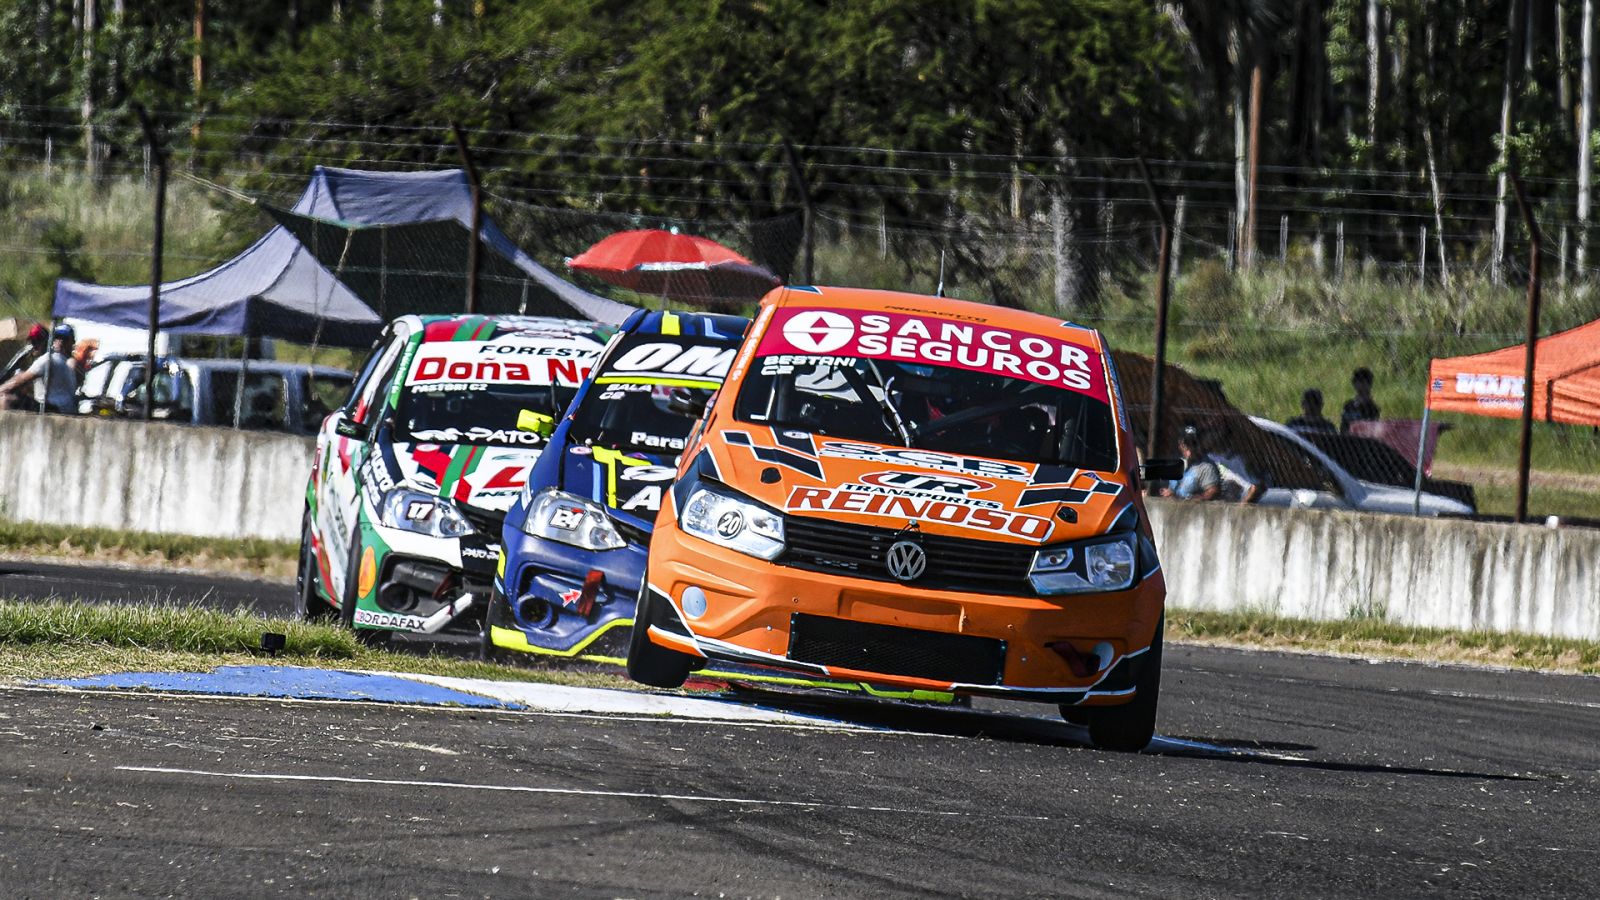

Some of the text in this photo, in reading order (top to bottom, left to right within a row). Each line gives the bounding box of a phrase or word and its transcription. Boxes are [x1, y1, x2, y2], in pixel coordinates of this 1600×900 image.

[860, 314, 1092, 373] SANCOR
[413, 357, 531, 381] Doña
[613, 342, 737, 378] OM
[761, 365, 794, 376] C2
[763, 355, 857, 367] BESTANI
[857, 334, 1091, 390] SEGUROS
[411, 383, 468, 394] PASTORI
[464, 427, 540, 444] PATO
[819, 441, 1031, 477] SGB
[843, 483, 1002, 510] TRANSPORTES
[406, 502, 434, 520] 17
[787, 487, 1052, 539] REINOSO
[719, 514, 740, 534] 20
[360, 611, 426, 632] BORDAFAX
